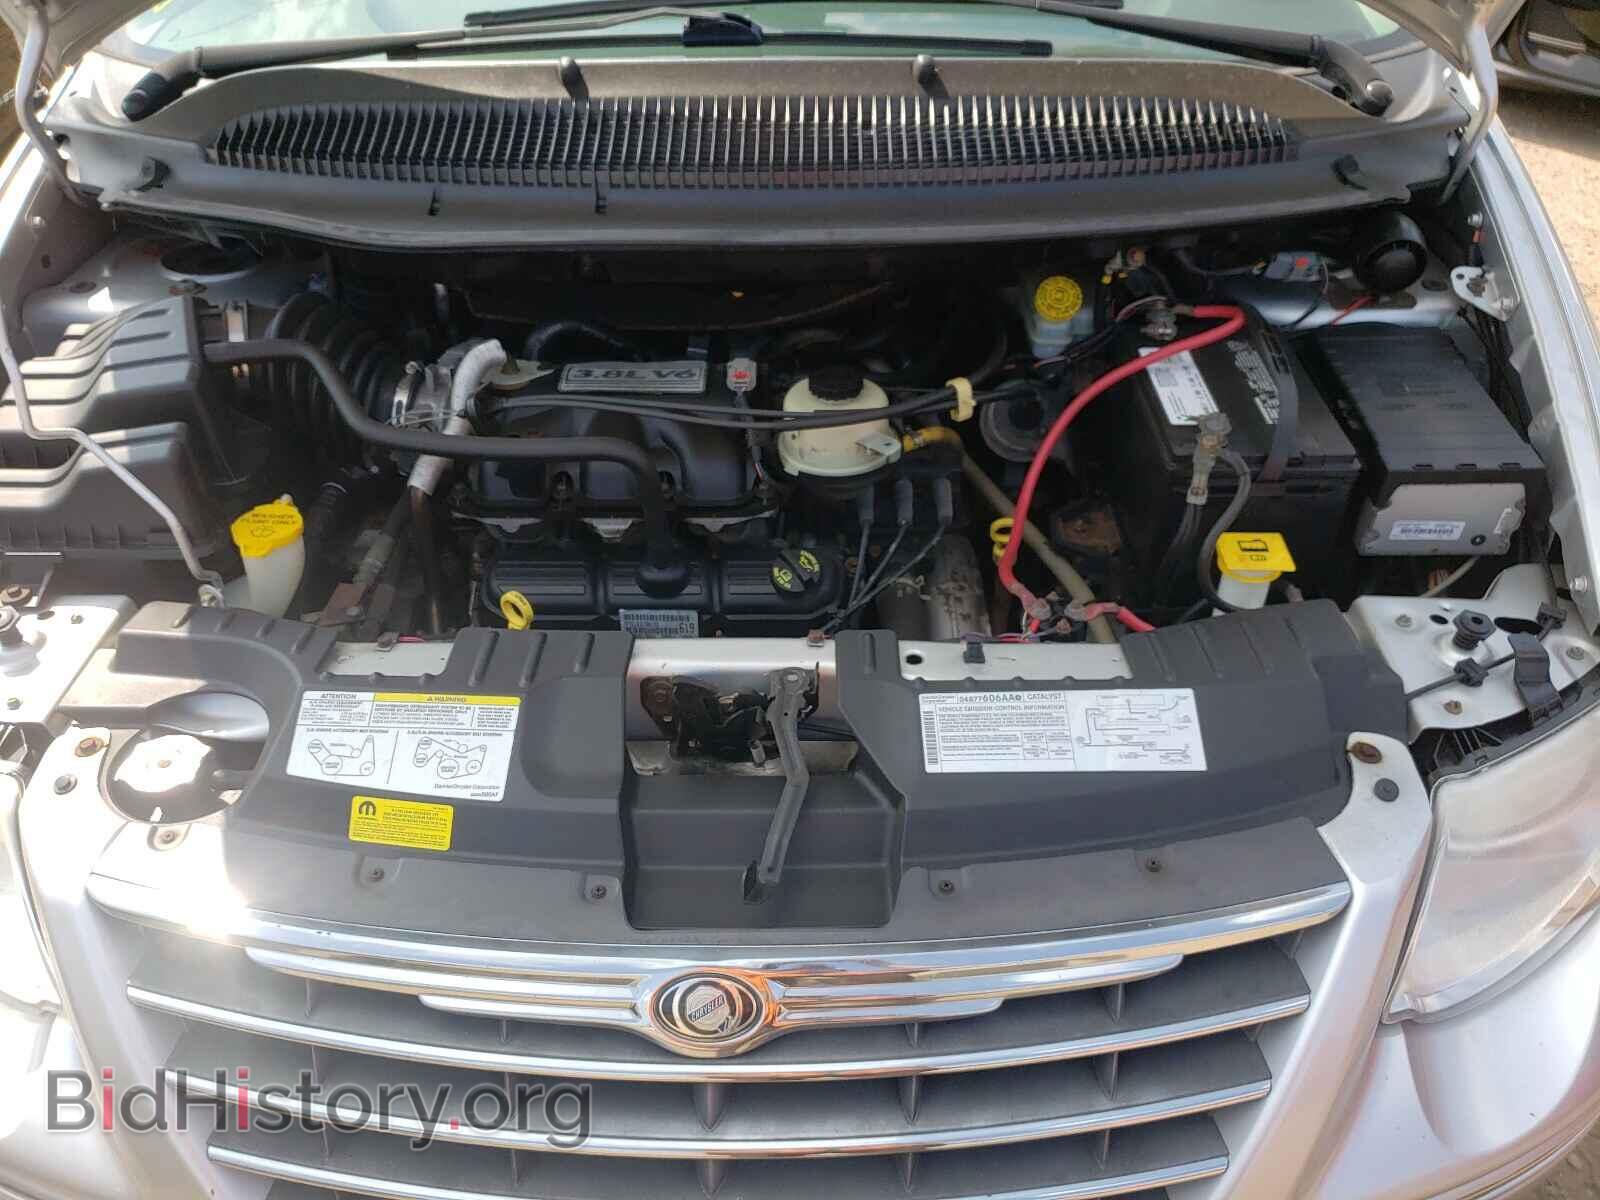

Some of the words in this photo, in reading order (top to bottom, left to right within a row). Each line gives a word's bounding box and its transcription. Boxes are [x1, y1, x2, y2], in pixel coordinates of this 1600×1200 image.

[575, 368, 641, 379] 3.8L
[653, 369, 697, 379] V6
[1026, 692, 1062, 701] CATALYST
[689, 994, 726, 1022] CHRYSLER
